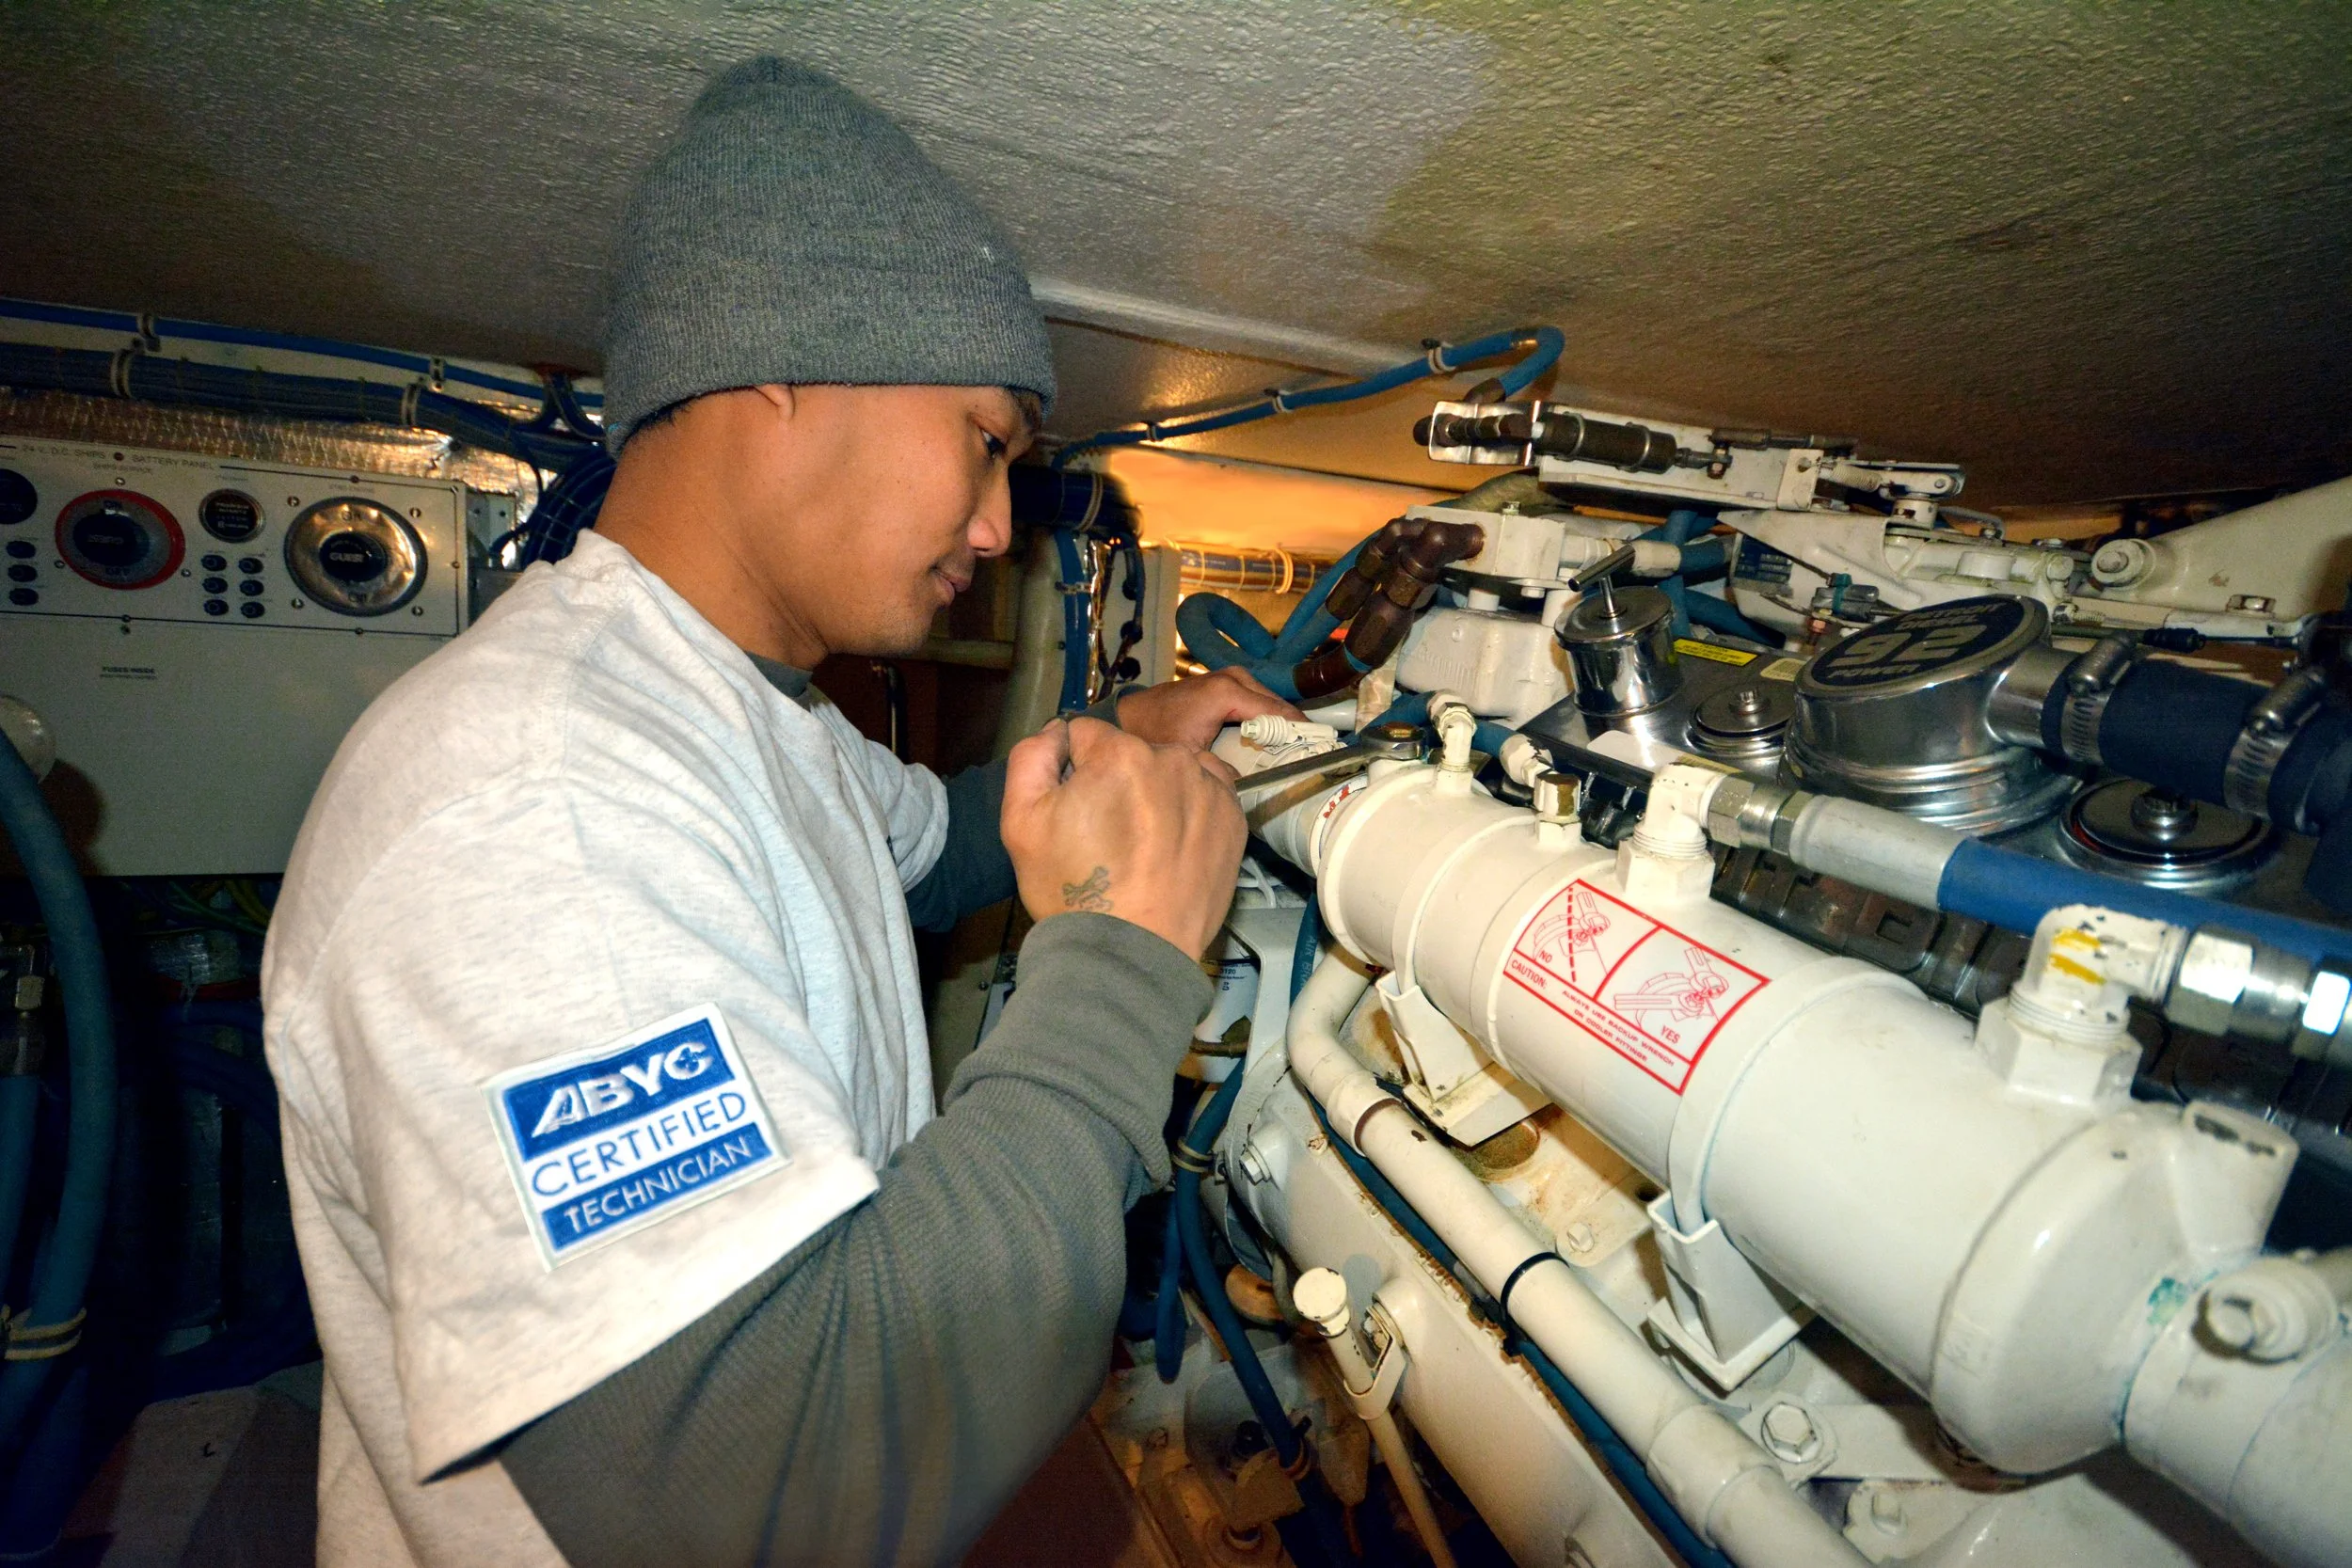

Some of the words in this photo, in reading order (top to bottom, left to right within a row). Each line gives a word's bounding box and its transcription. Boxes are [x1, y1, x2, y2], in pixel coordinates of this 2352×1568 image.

[132, 453, 179, 467] BATTERY
[182, 457, 215, 469] PANEL
[1825, 623, 1988, 670] 92
[1827, 662, 1921, 679] POWER
[1305, 934, 1317, 957] AIR
[1539, 950, 1552, 963] NO
[1562, 990, 1590, 1011] ALWAYS
[1592, 1008, 1607, 1022] USE
[1608, 1019, 1639, 1042] BACKUP
[1641, 1039, 1675, 1067] WRENCH
[1585, 1017, 1613, 1038] COOLER
[1615, 1036, 1648, 1062] FITTINGS
[1661, 1024, 1681, 1044] YES
[532, 1041, 713, 1138] ABYC
[532, 1091, 746, 1196] CERTIFIED
[564, 1135, 753, 1233] TECHNICIAN
